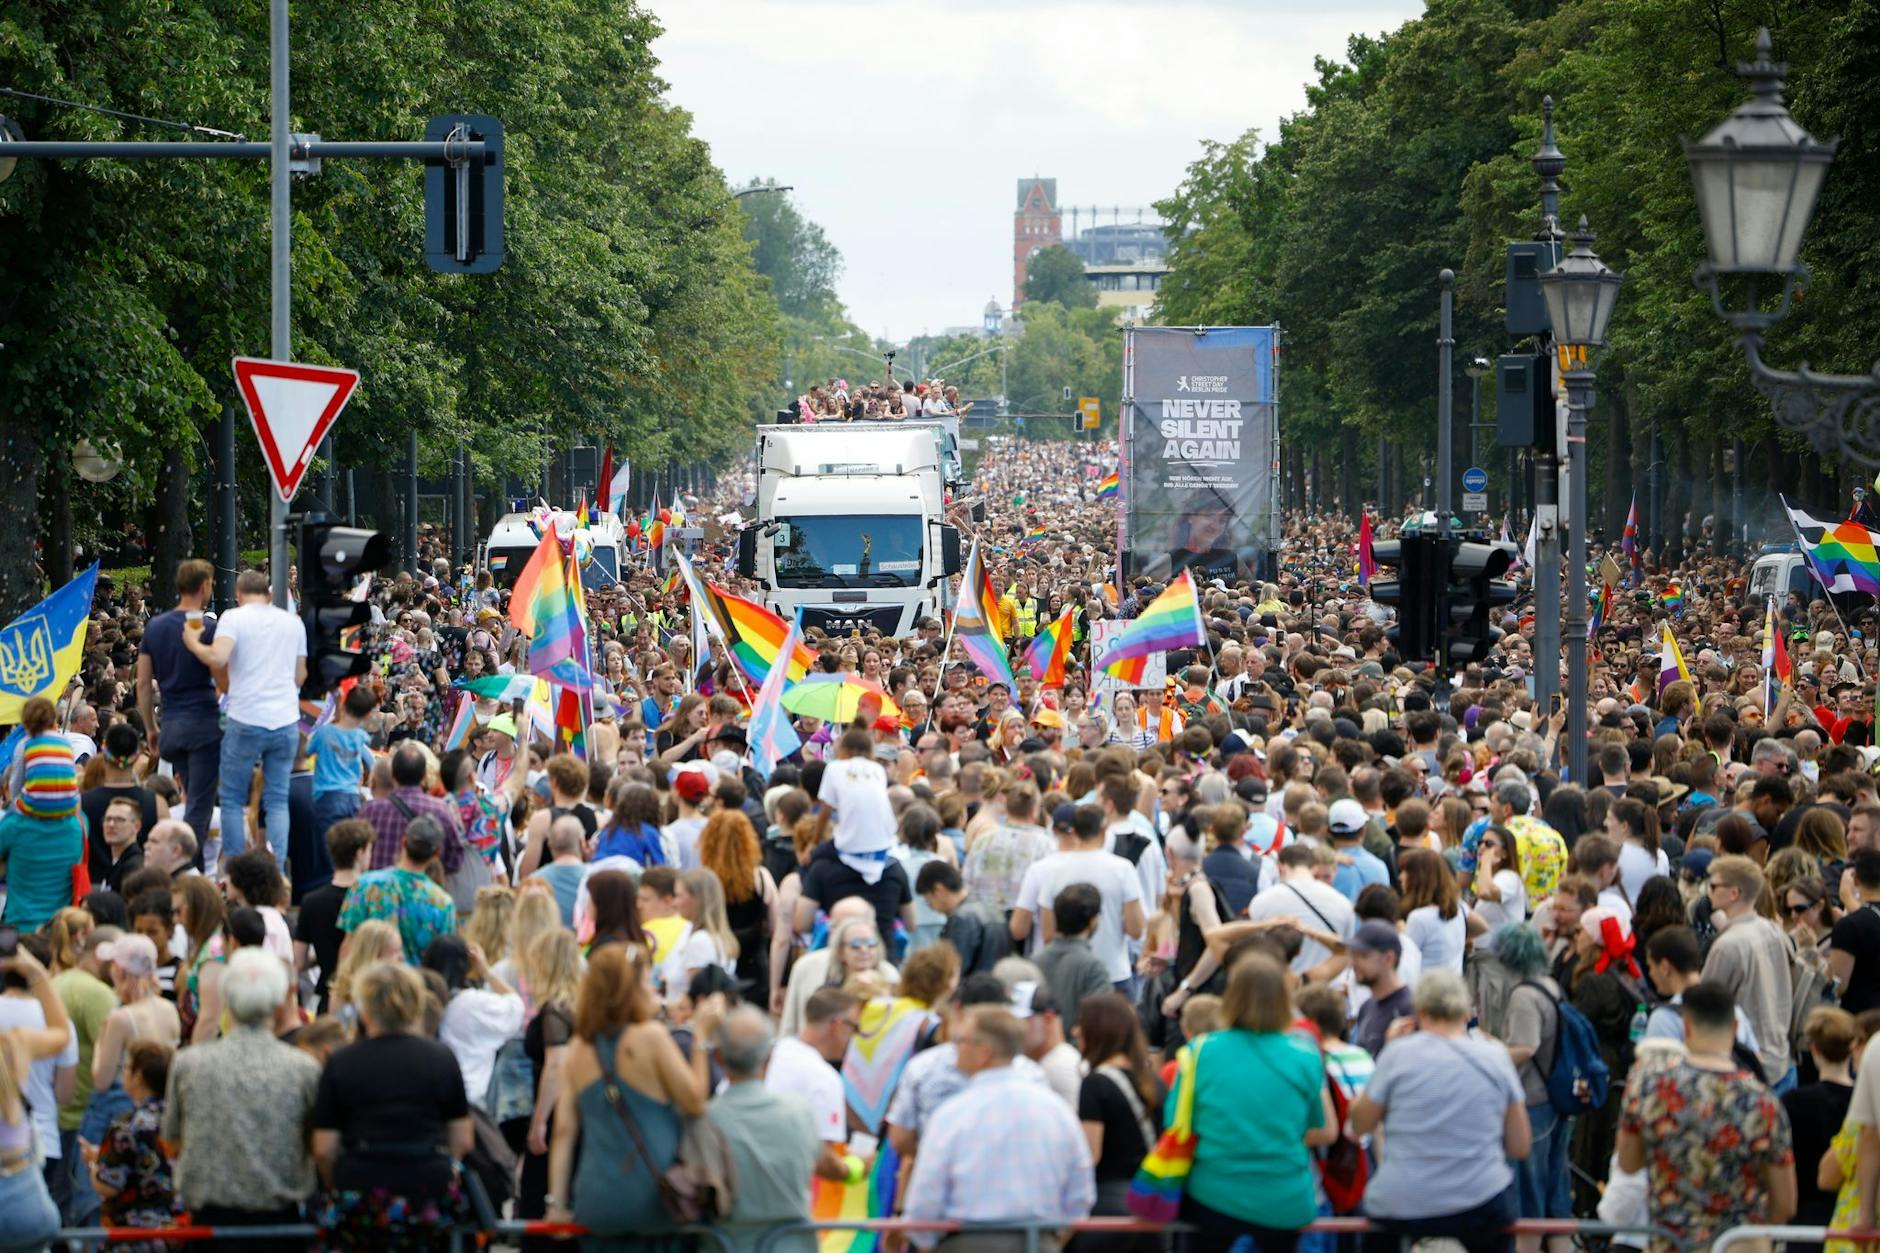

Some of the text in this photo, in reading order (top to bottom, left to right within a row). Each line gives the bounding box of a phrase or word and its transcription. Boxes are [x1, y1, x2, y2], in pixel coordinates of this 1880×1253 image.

[1162, 399, 1241, 418] NEVER
[1160, 419, 1244, 439] SILENT
[1162, 440, 1241, 460] AGAIN
[779, 534, 786, 543] 3
[825, 619, 872, 630] MAN
